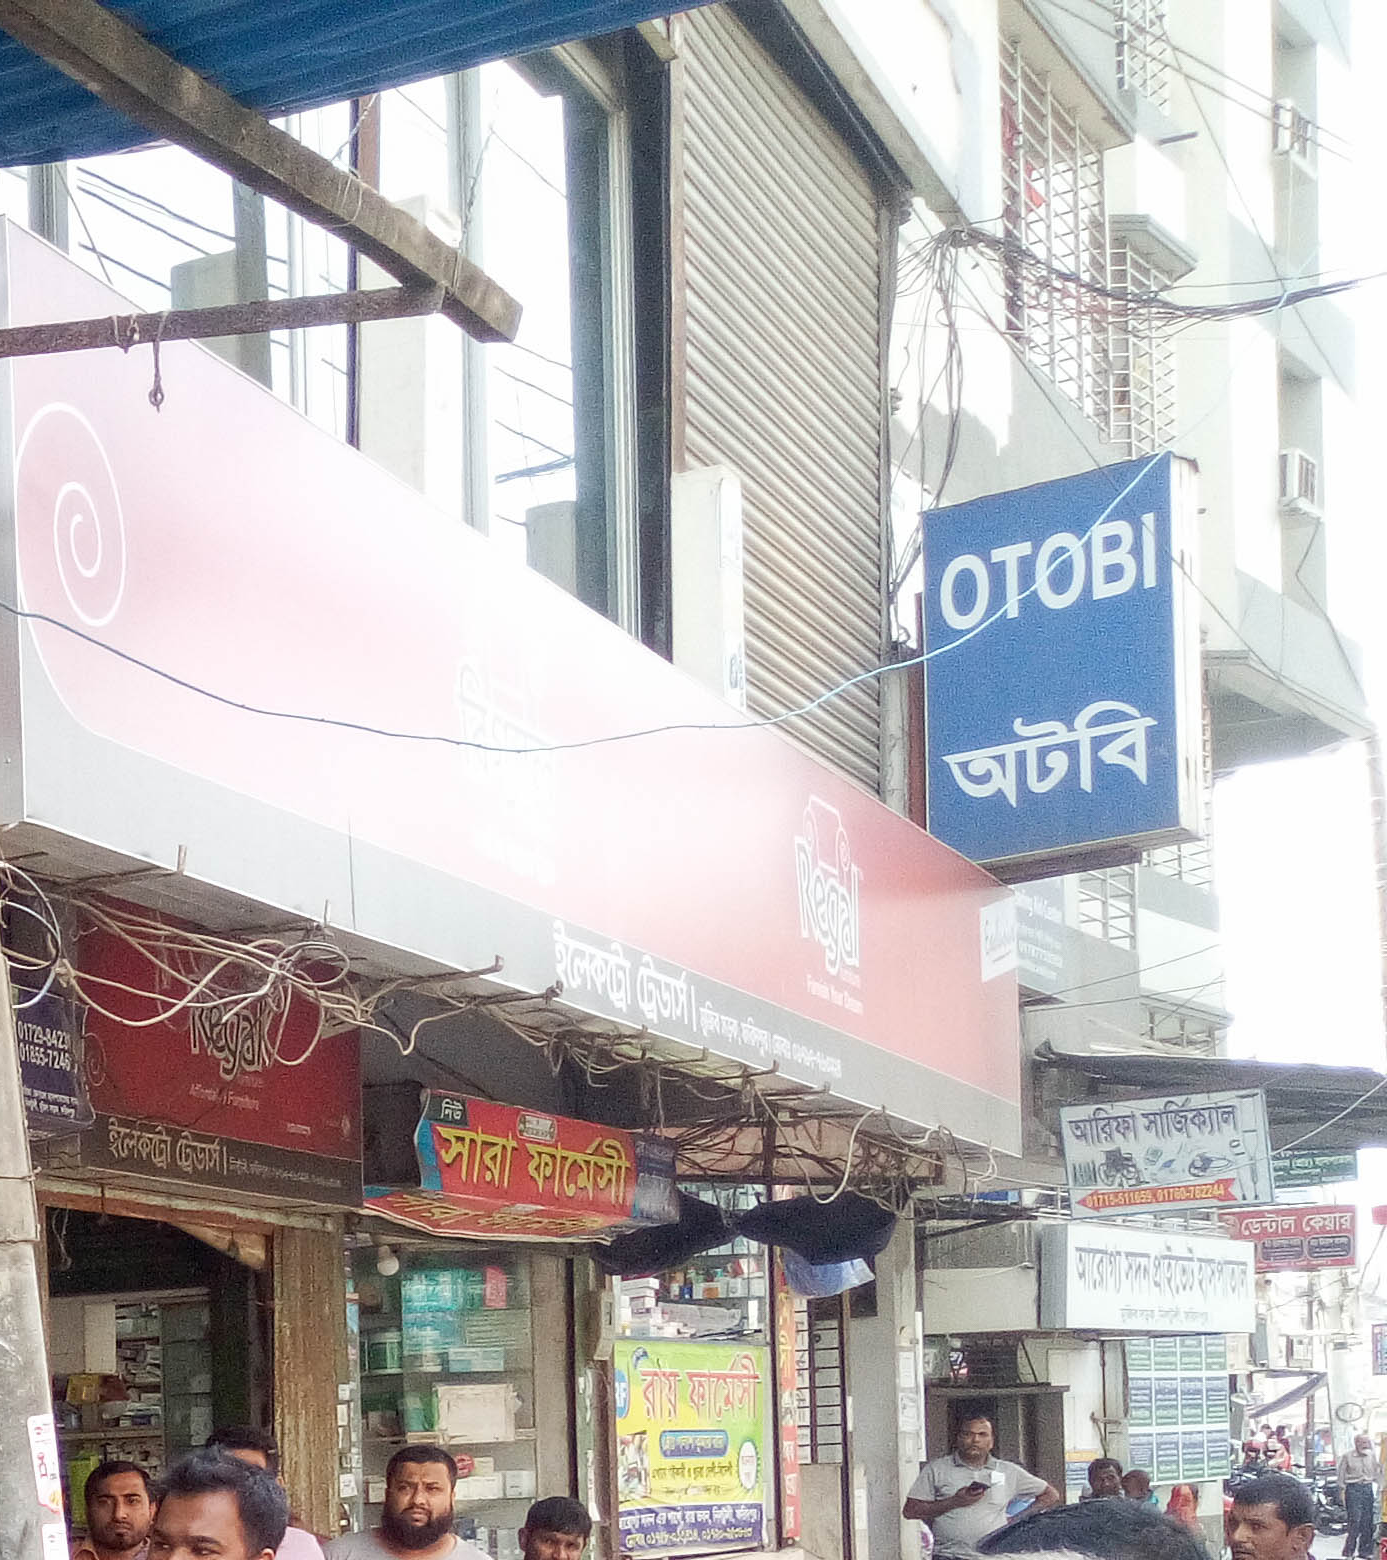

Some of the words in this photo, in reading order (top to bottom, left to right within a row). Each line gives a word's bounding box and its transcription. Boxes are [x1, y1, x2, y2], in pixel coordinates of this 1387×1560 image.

[940, 513, 1157, 630] OTOBI
[941, 700, 1157, 808] অটবি
[795, 836, 860, 976] Regal
[439, 1098, 465, 1121] নিউ
[1066, 1106, 1137, 1146] আরিফা
[1140, 1096, 1239, 1140] সার্জিক্যাল
[436, 1126, 518, 1189] সারা
[526, 1137, 632, 1206] ফার্মেসী
[1241, 1212, 1297, 1236] ডেন্টাল
[1302, 1212, 1354, 1233] কেয়ার
[639, 1368, 681, 1420] রায়
[686, 1353, 761, 1421] ফার্মেসী
